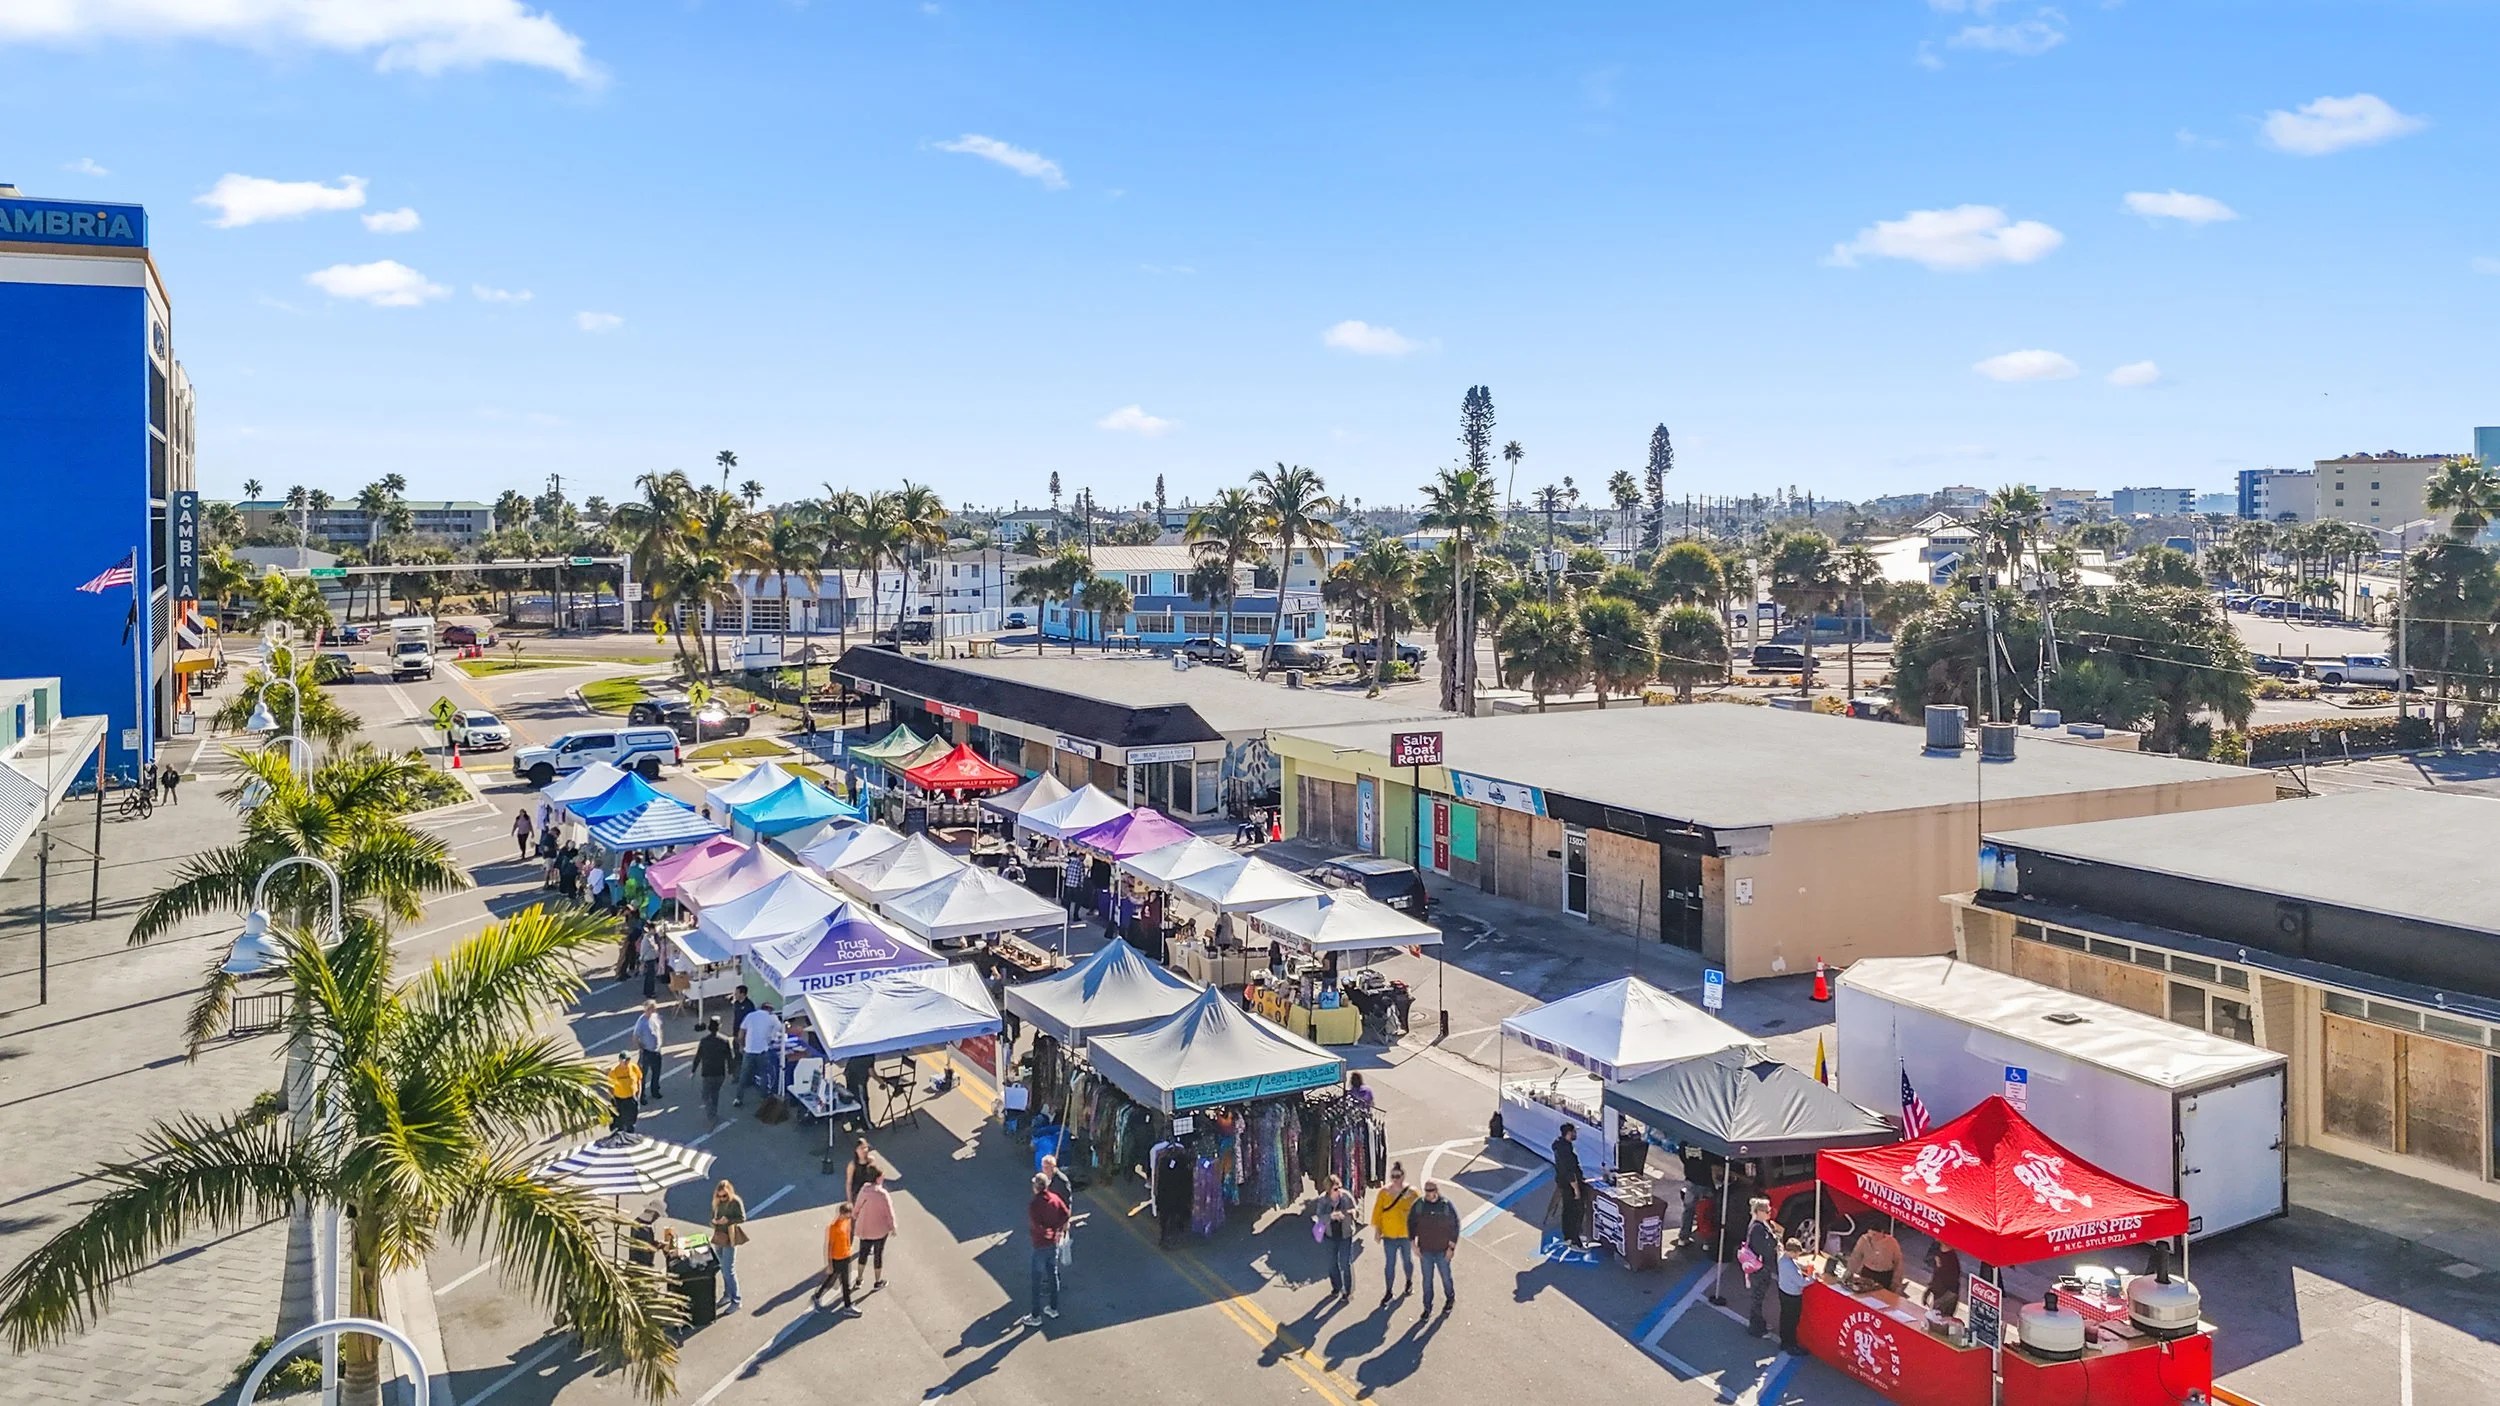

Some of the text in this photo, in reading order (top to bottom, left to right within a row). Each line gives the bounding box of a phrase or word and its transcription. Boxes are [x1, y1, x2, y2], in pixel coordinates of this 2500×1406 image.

[1402, 735, 1438, 748] Salty
[1404, 745, 1435, 756] Boat
[1398, 752, 1441, 765] Rental
[835, 938, 871, 950] Trust
[837, 946, 887, 961] Roofing
[800, 973, 856, 992] TRUST
[1264, 1071, 1293, 1086] legal
[1296, 1066, 1336, 1083] pajamas
[1177, 1085, 1206, 1100] legal
[1210, 1080, 1251, 1096] pajamas
[1856, 1174, 1946, 1227] VINNIE'S PIES
[1890, 1206, 1911, 1221] STYLE
[1911, 1215, 1930, 1230] PIZZA
[2045, 1215, 2142, 1243] VINNIE'S PIES
[2085, 1237, 2106, 1247] STYLE
[2107, 1234, 2127, 1243] PIZZA
[1838, 1312, 1882, 1347] VINNIE'S
[1884, 1333, 1900, 1376] PIES
